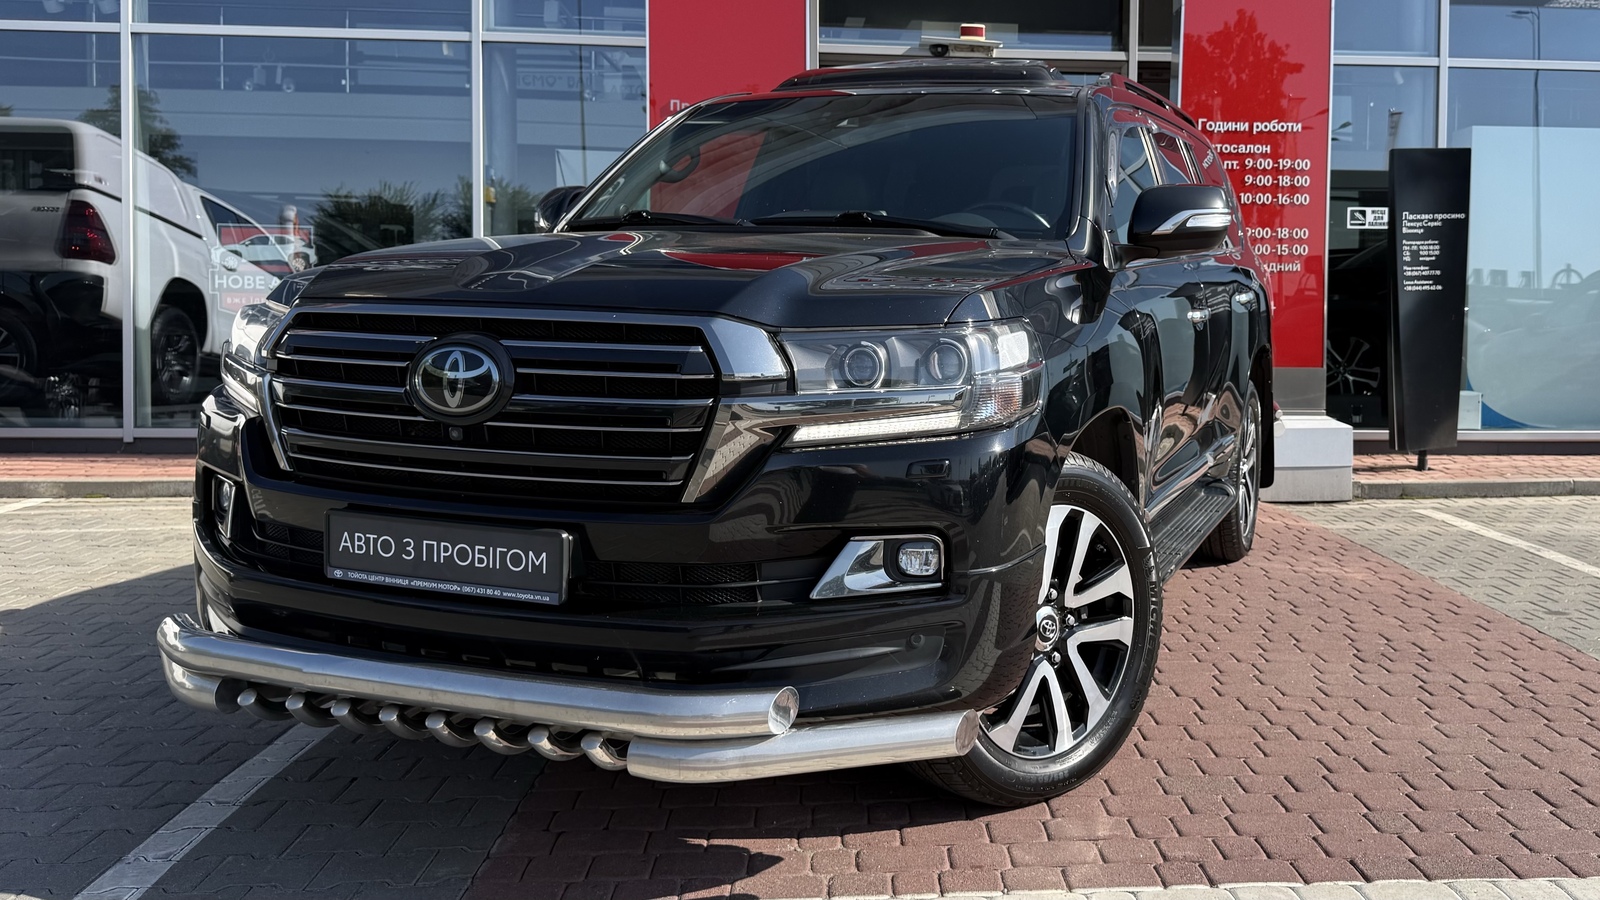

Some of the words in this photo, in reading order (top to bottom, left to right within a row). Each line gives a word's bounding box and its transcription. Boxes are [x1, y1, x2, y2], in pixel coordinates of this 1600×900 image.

[670, 99, 690, 111] Пр
[1197, 118, 1249, 133] Години
[1253, 119, 1302, 135] роботи
[1212, 143, 1271, 154] тосалон
[1245, 158, 1311, 170] 9:00-19:00
[1244, 174, 1310, 187] 9:00-18:00
[1239, 192, 1310, 205] 10:00-16:00
[1402, 211, 1433, 220] Ласкаво
[215, 274, 265, 289] НОВЕ
[338, 531, 395, 558] АВТО
[401, 538, 415, 560] З
[422, 540, 548, 574] ПРОБІГОМ
[348, 571, 368, 580] ТОЙОТА
[368, 574, 385, 582] ЦЕНТР
[385, 576, 409, 585] ВІННИЦЯ
[461, 585, 476, 594] (067)
[502, 591, 550, 601] www.toyota.vn.ua
